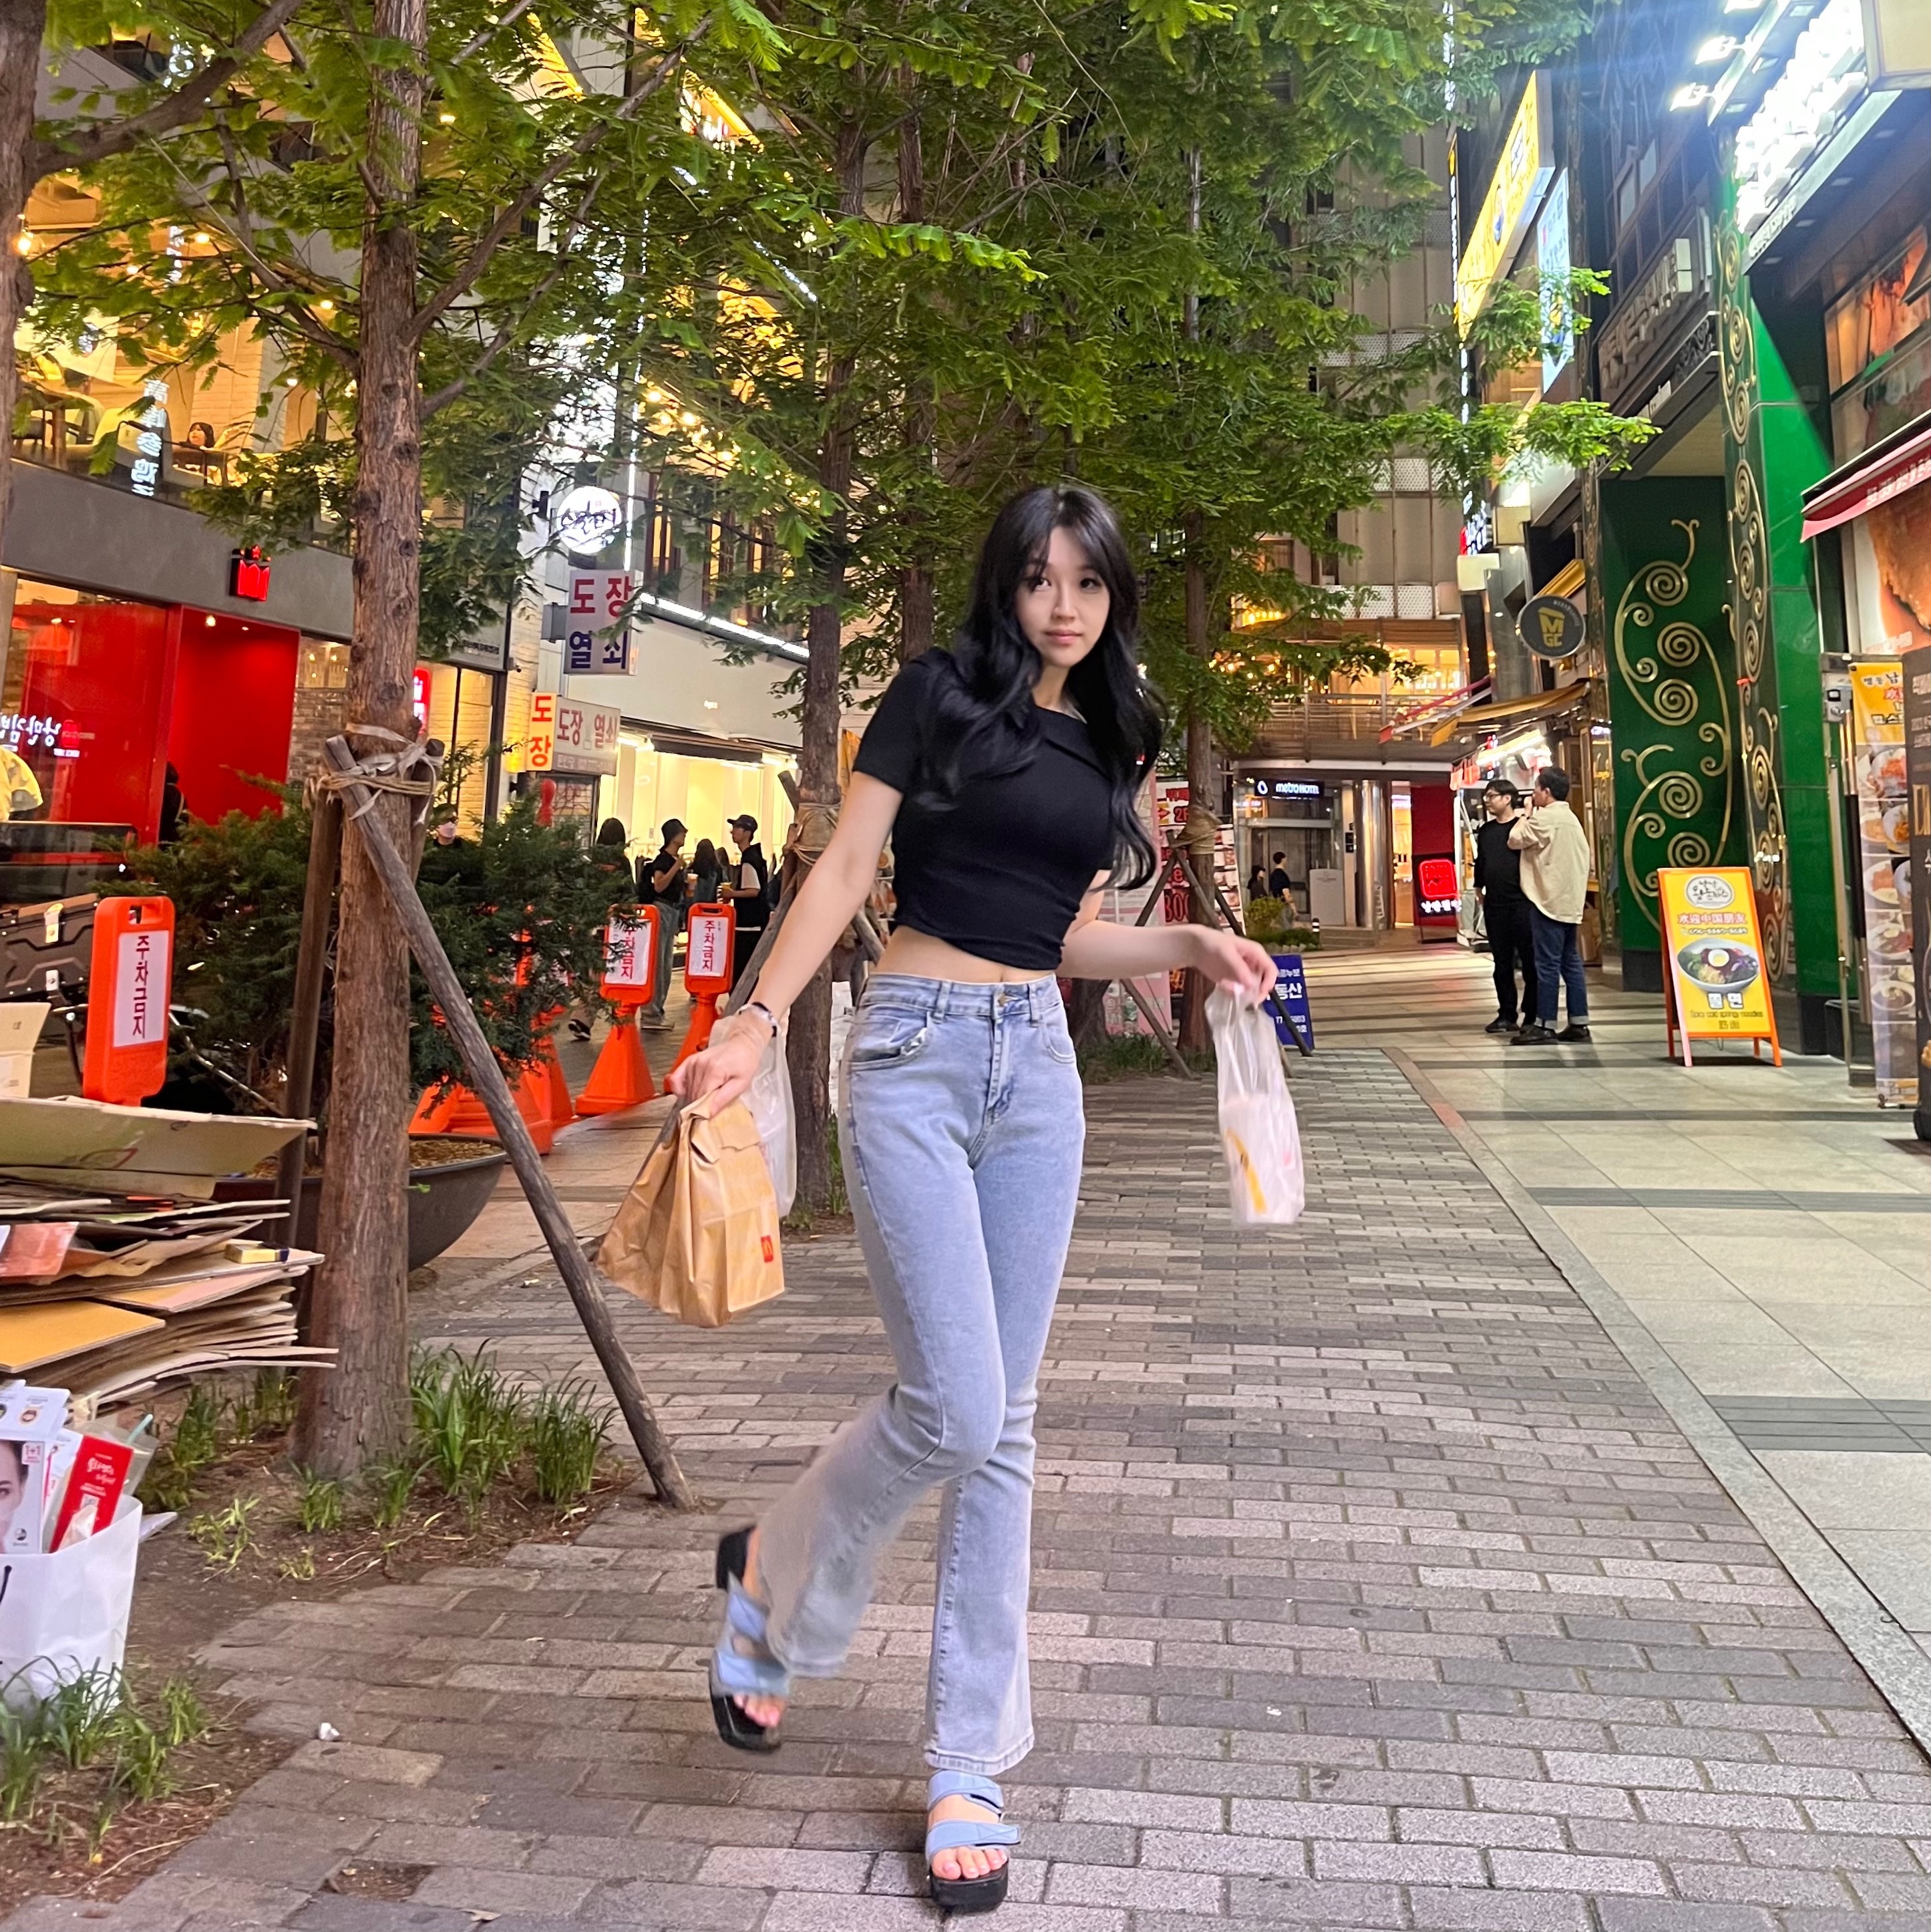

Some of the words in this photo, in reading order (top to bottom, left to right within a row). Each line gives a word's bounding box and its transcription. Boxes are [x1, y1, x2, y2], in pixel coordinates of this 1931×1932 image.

[570, 576, 632, 617] 도장
[569, 631, 629, 669] 열쇠
[530, 695, 552, 768] 도장
[557, 707, 584, 746] 도장
[594, 713, 618, 750] 열쇠
[702, 919, 715, 972] 주차금지
[132, 935, 150, 1039] 주차금지
[1267, 982, 1302, 1000] 동산
